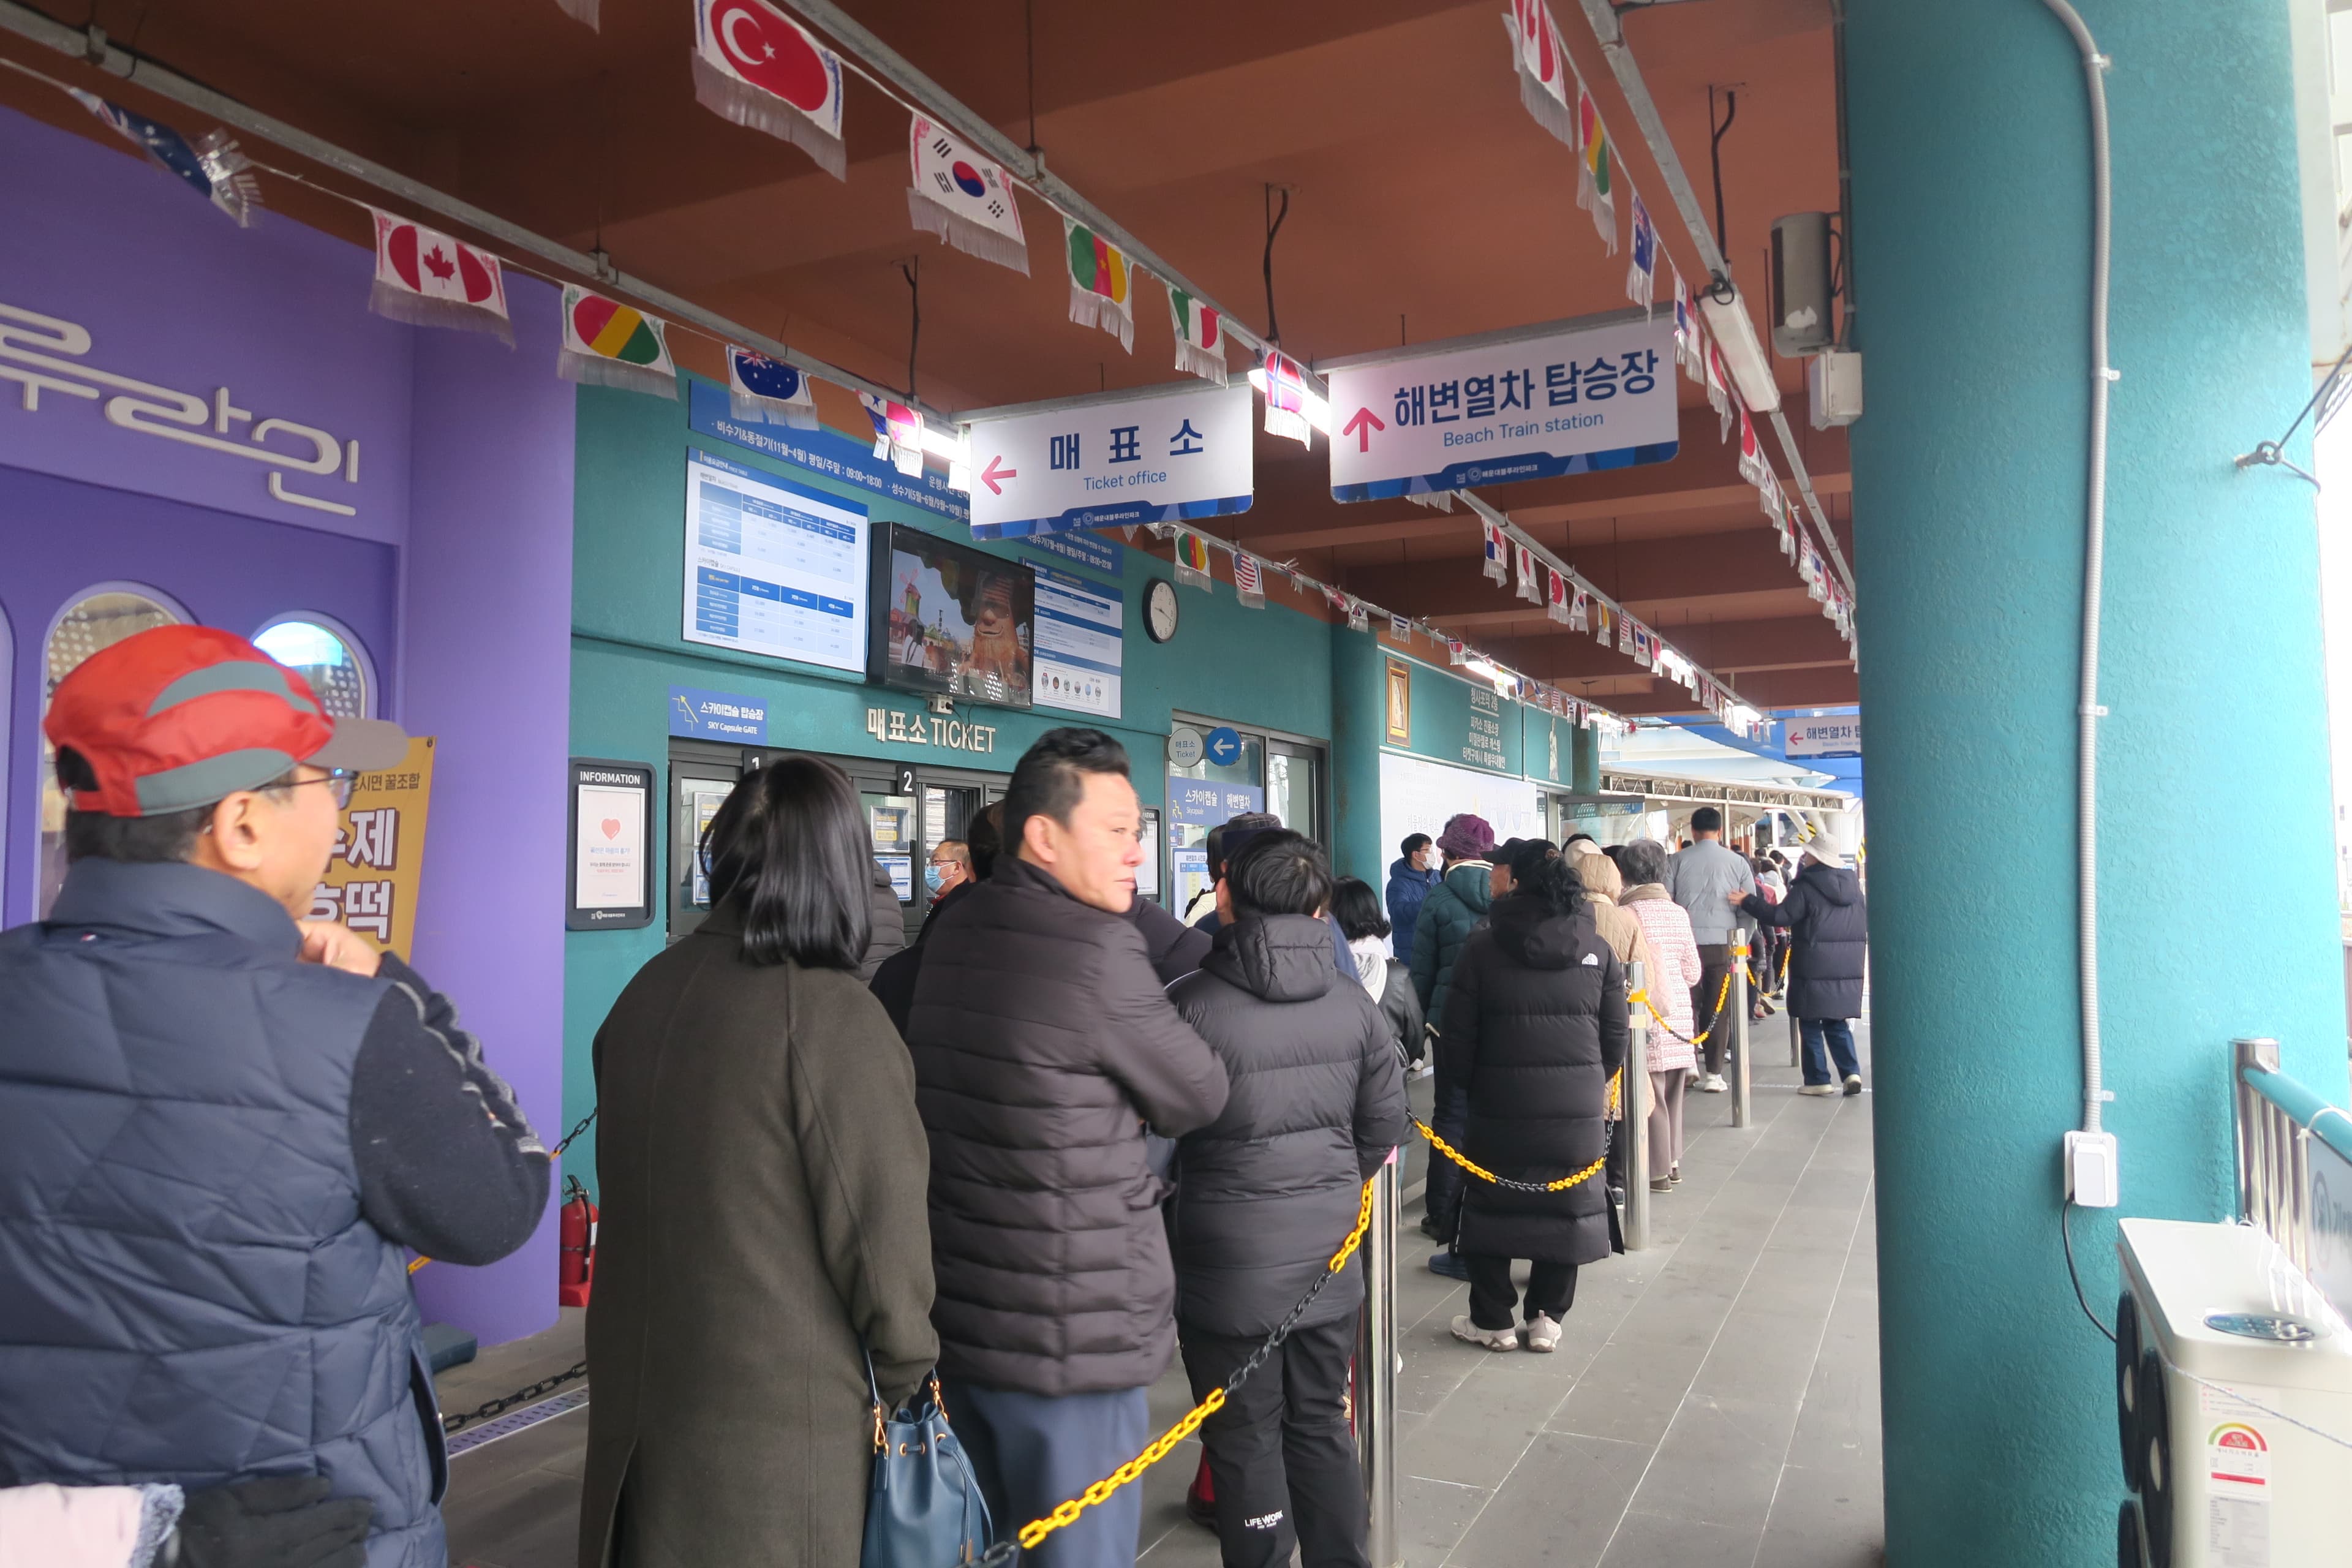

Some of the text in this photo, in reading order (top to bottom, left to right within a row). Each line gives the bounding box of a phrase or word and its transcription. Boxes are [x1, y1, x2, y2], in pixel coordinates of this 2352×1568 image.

[1394, 349, 1659, 426] 해변열차 탑승장
[1443, 413, 1604, 447] Beach Train station
[809, 452, 840, 475] 평일/주말
[846, 467, 882, 488] 09:00~18:00
[1084, 470, 1167, 491] Ticket office
[700, 701, 764, 721] 스카이캡슐 탑승장
[720, 723, 742, 733] Capsule
[743, 726, 758, 734] GATE
[867, 708, 996, 753] 매표소 TICKET
[1806, 725, 1852, 739] 해변열차
[752, 756, 760, 769] 1
[385, 772, 420, 790] 꿀조합
[580, 771, 640, 785] INFORMATION
[903, 771, 913, 792] 2
[1185, 789, 1251, 810] 스카이캡슐 해변열차
